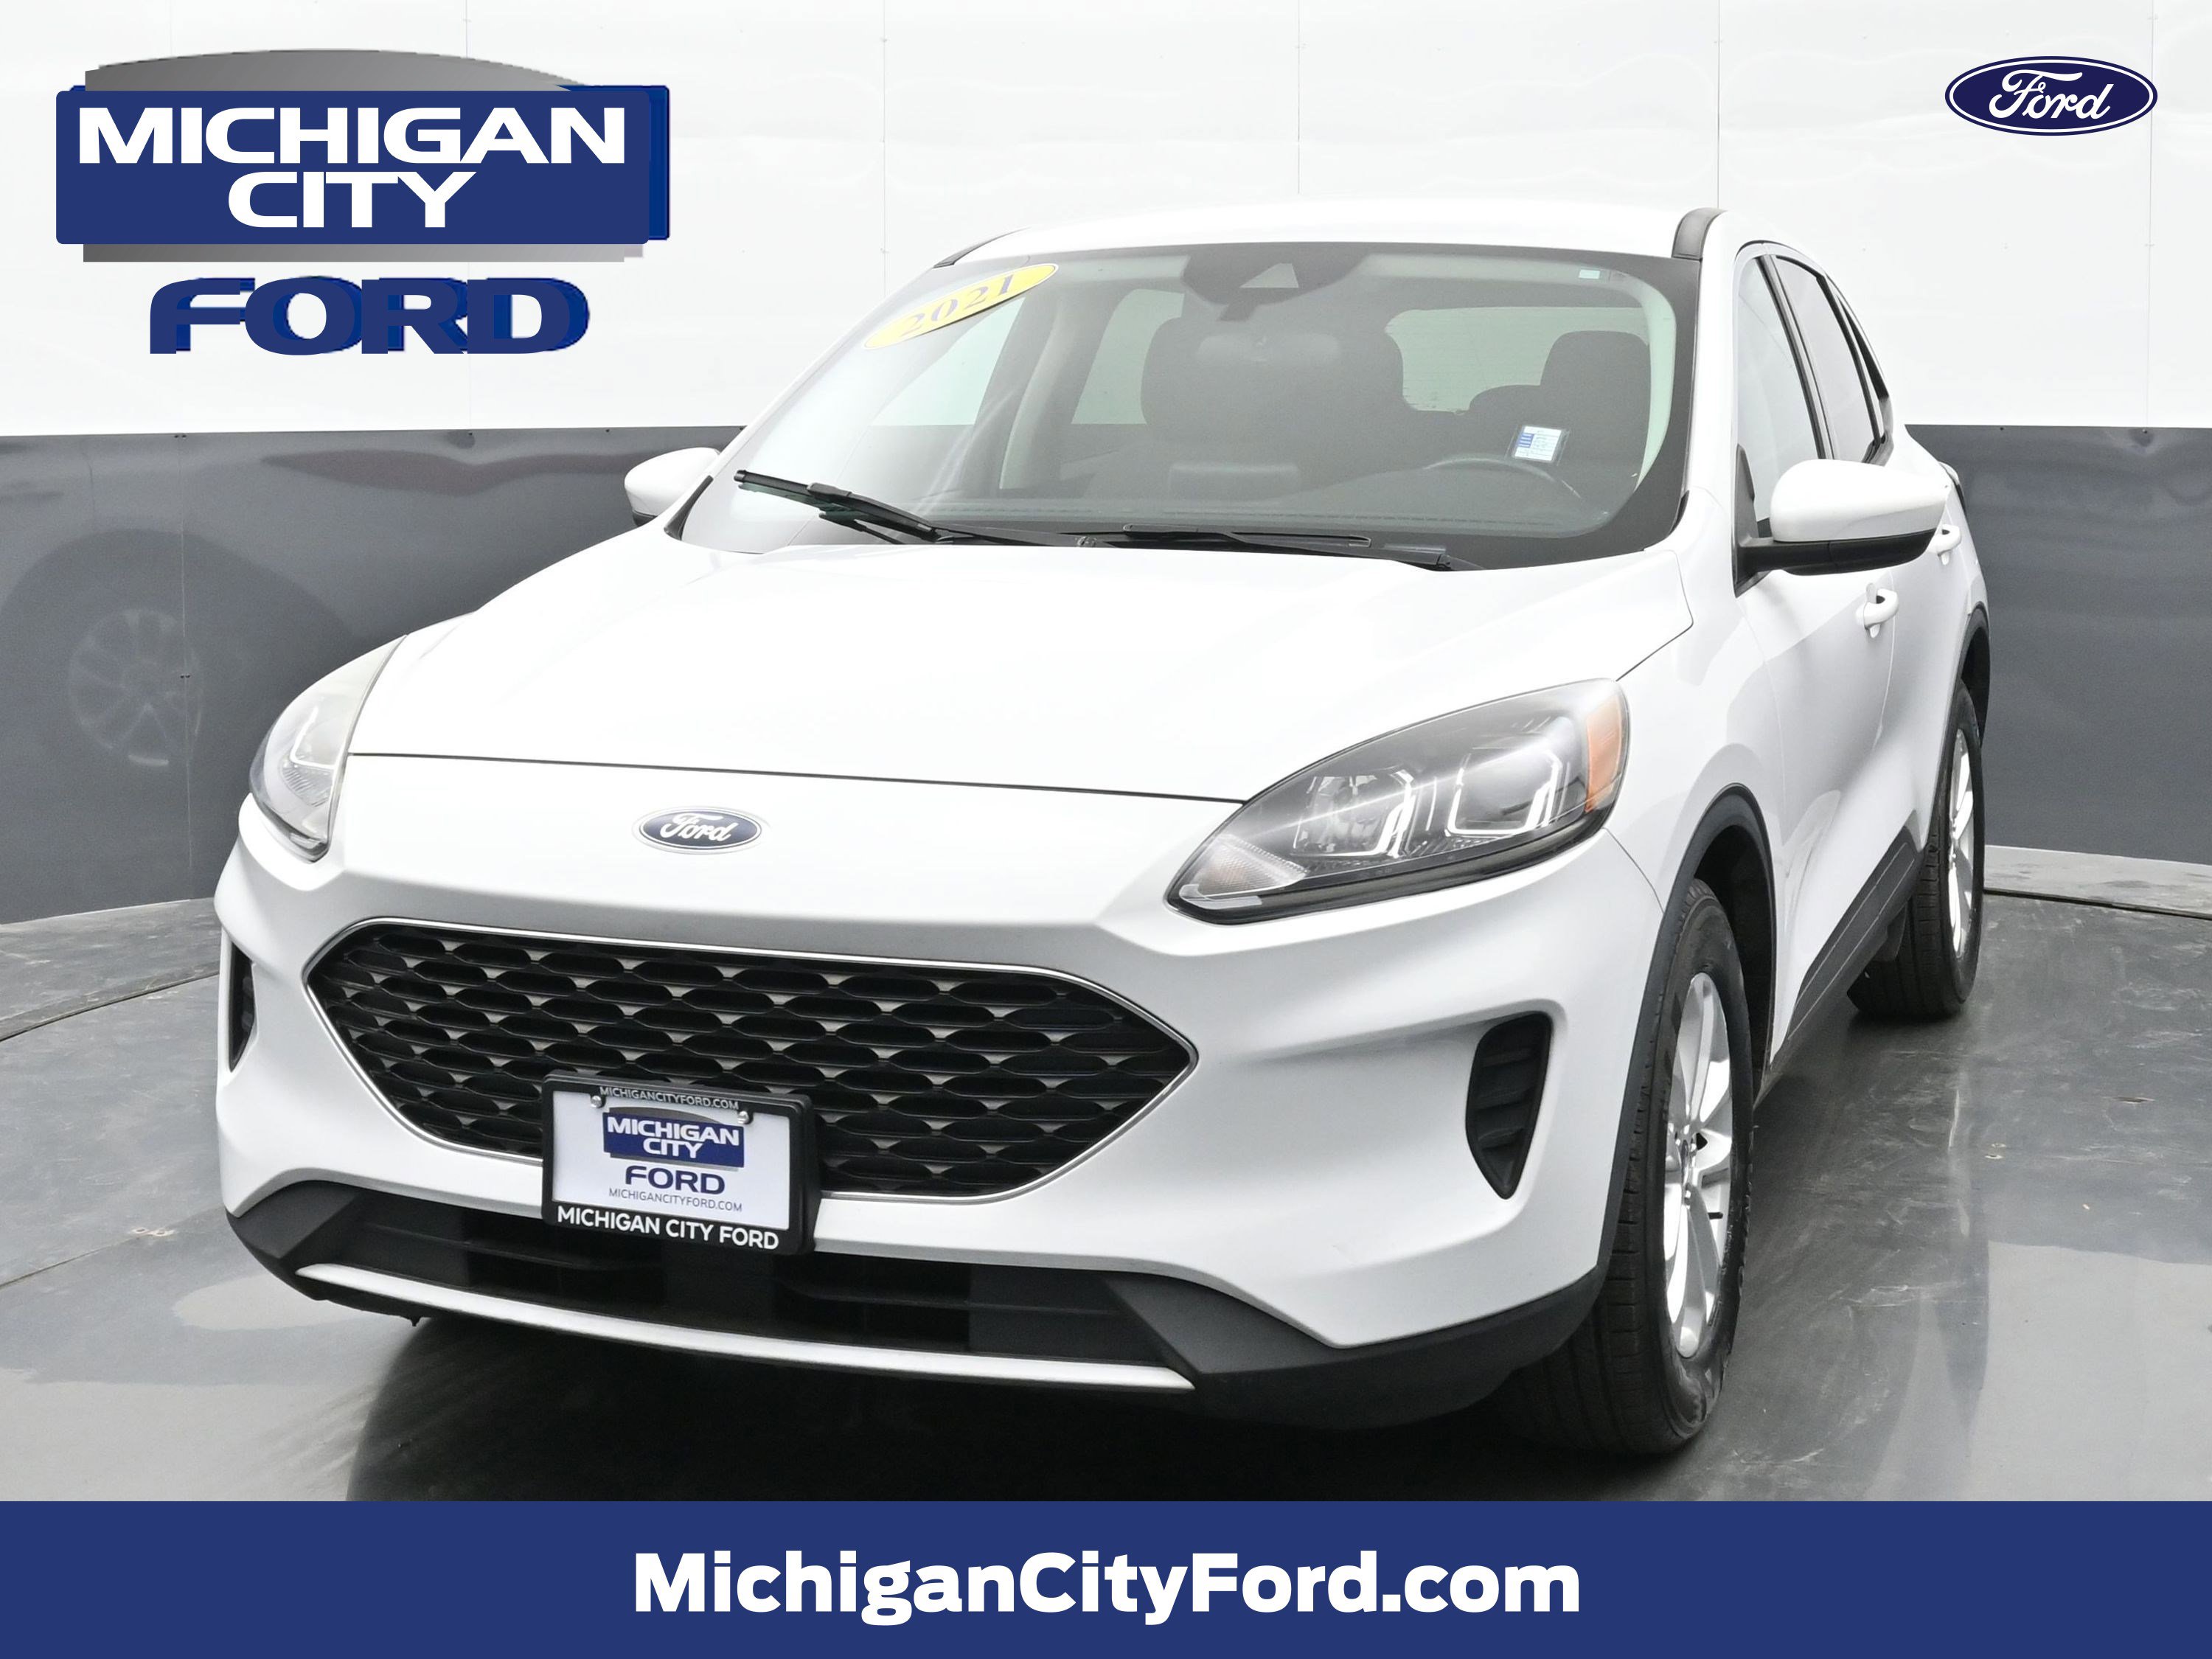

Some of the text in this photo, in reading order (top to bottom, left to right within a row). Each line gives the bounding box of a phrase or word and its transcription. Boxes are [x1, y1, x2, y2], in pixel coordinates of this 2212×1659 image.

[899, 274, 1014, 338] 2021
[660, 813, 739, 841] Ford
[599, 1086, 739, 1110] MICHIGANCITYFORD.COM
[607, 1116, 740, 1146] MICHIGAN
[643, 1138, 703, 1158] CITY
[625, 1165, 726, 1195] FORD
[609, 1188, 742, 1212] MICHIGANCITYFORD.COM
[557, 1205, 779, 1251] MICHIGAN CITY FORD
